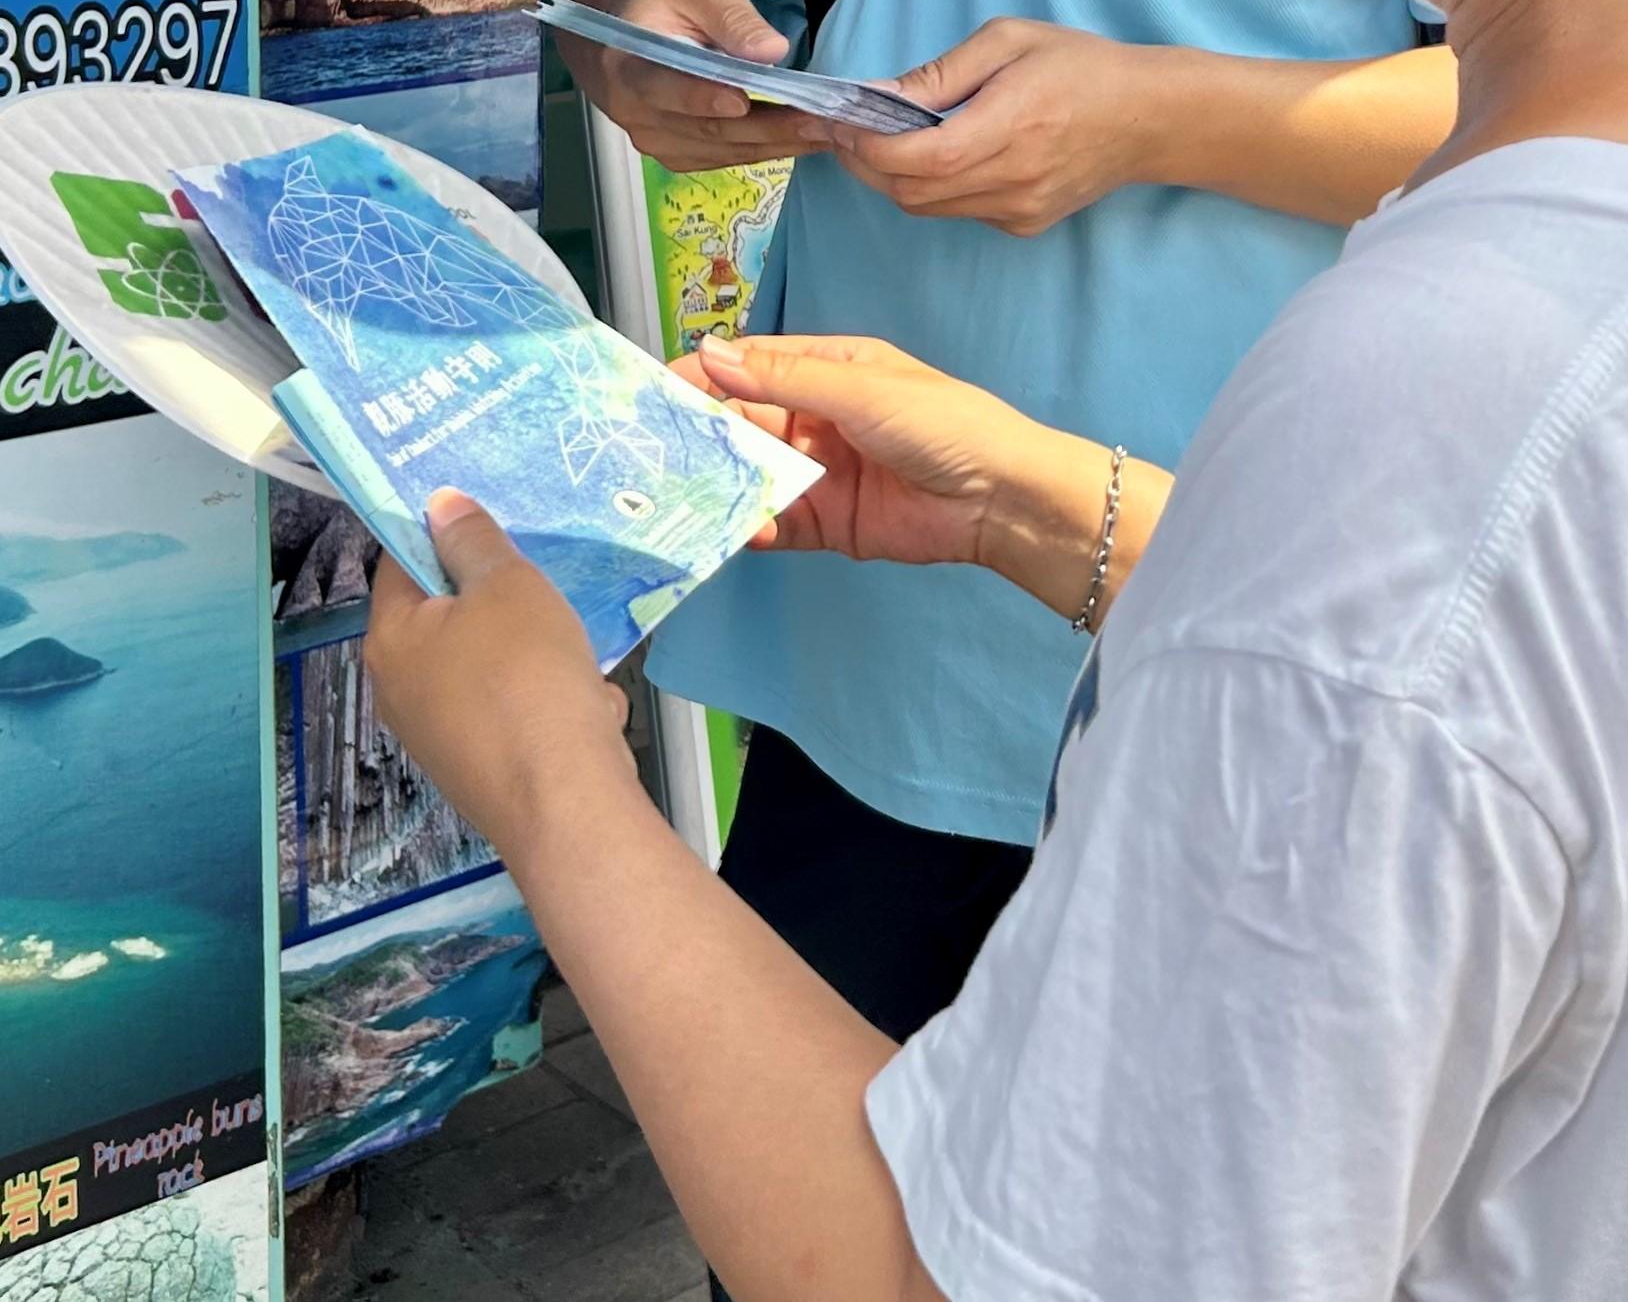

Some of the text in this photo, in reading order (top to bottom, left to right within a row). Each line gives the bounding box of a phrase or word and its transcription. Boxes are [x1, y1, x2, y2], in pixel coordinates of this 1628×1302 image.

[676, 223, 719, 239] Sai Kung
[92, 1108, 204, 1179] Pineapple
[157, 1148, 206, 1199] rock
[0, 1156, 81, 1244] 岩石
